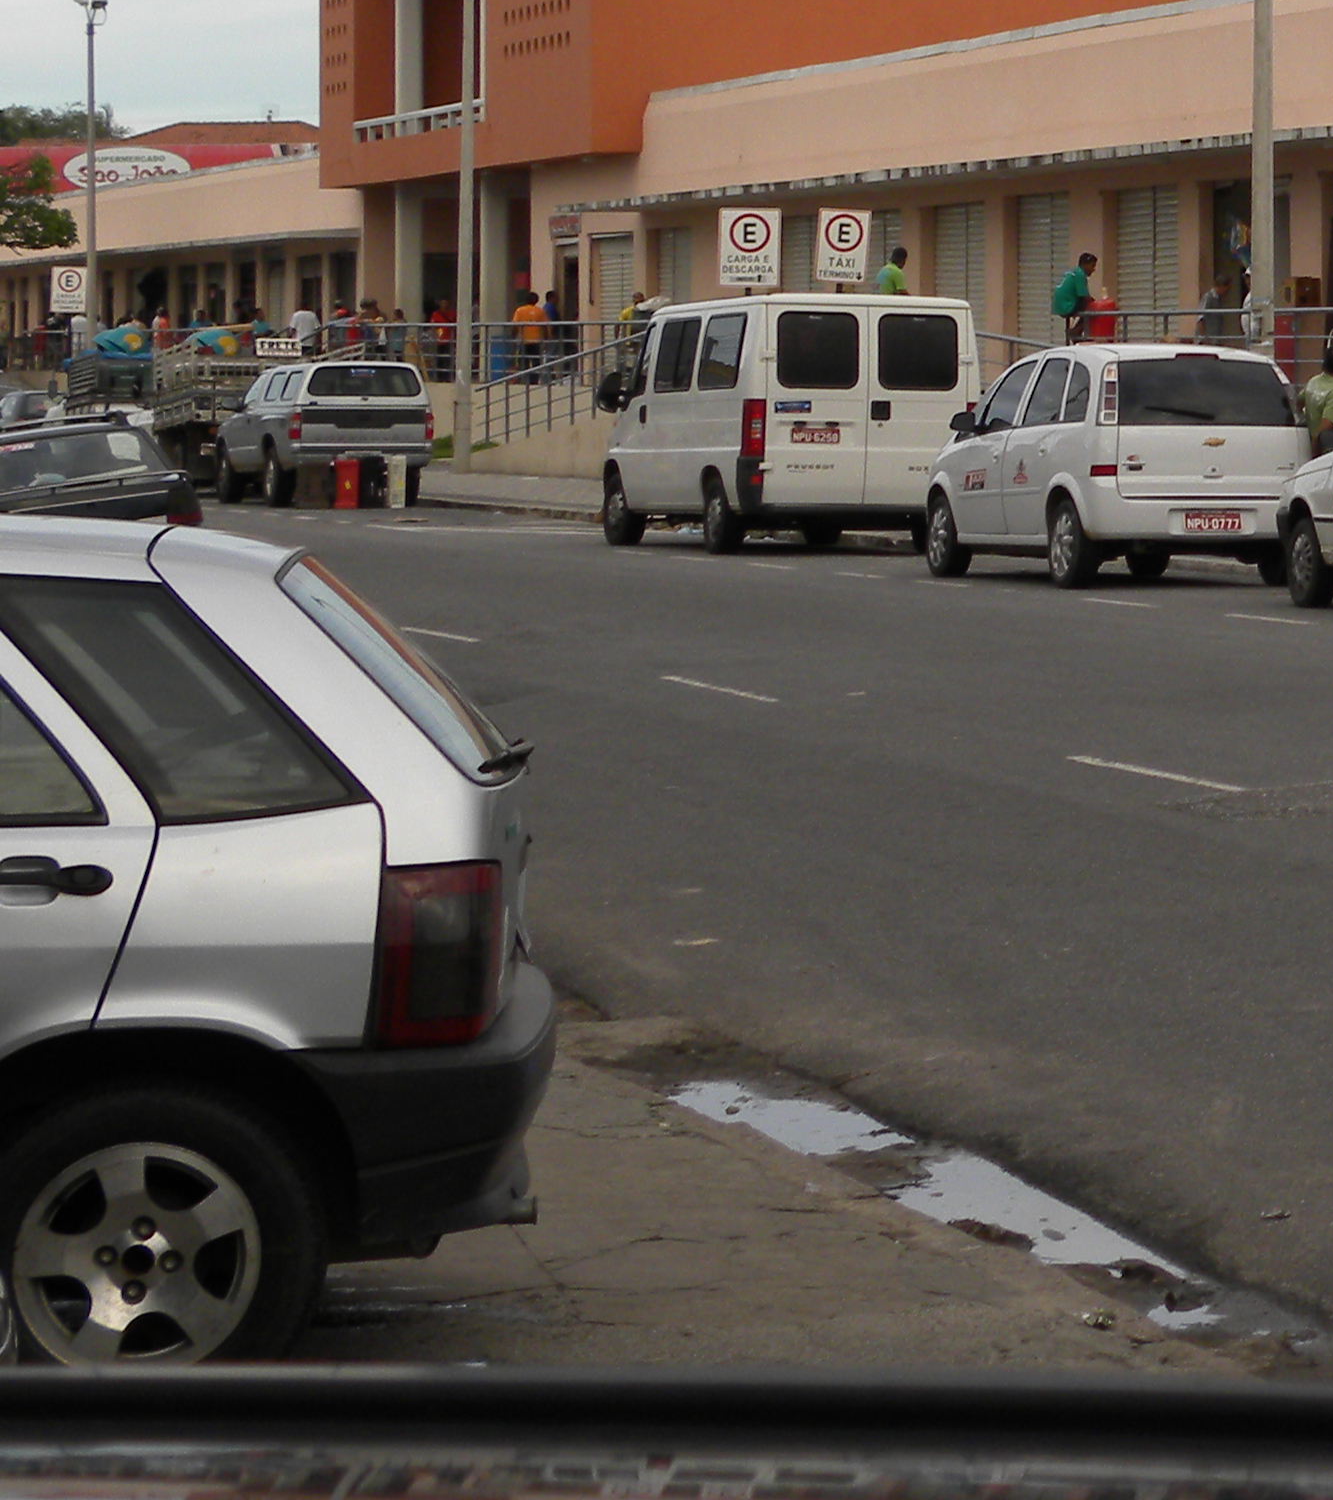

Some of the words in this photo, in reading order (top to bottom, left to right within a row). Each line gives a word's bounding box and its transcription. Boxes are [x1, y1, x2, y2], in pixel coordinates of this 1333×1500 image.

[743, 223, 757, 243] E
[837, 223, 852, 243] E
[727, 254, 762, 264] CARGA
[763, 254, 770, 264] E
[721, 265, 774, 274] DESCARGA
[65, 274, 74, 287] E
